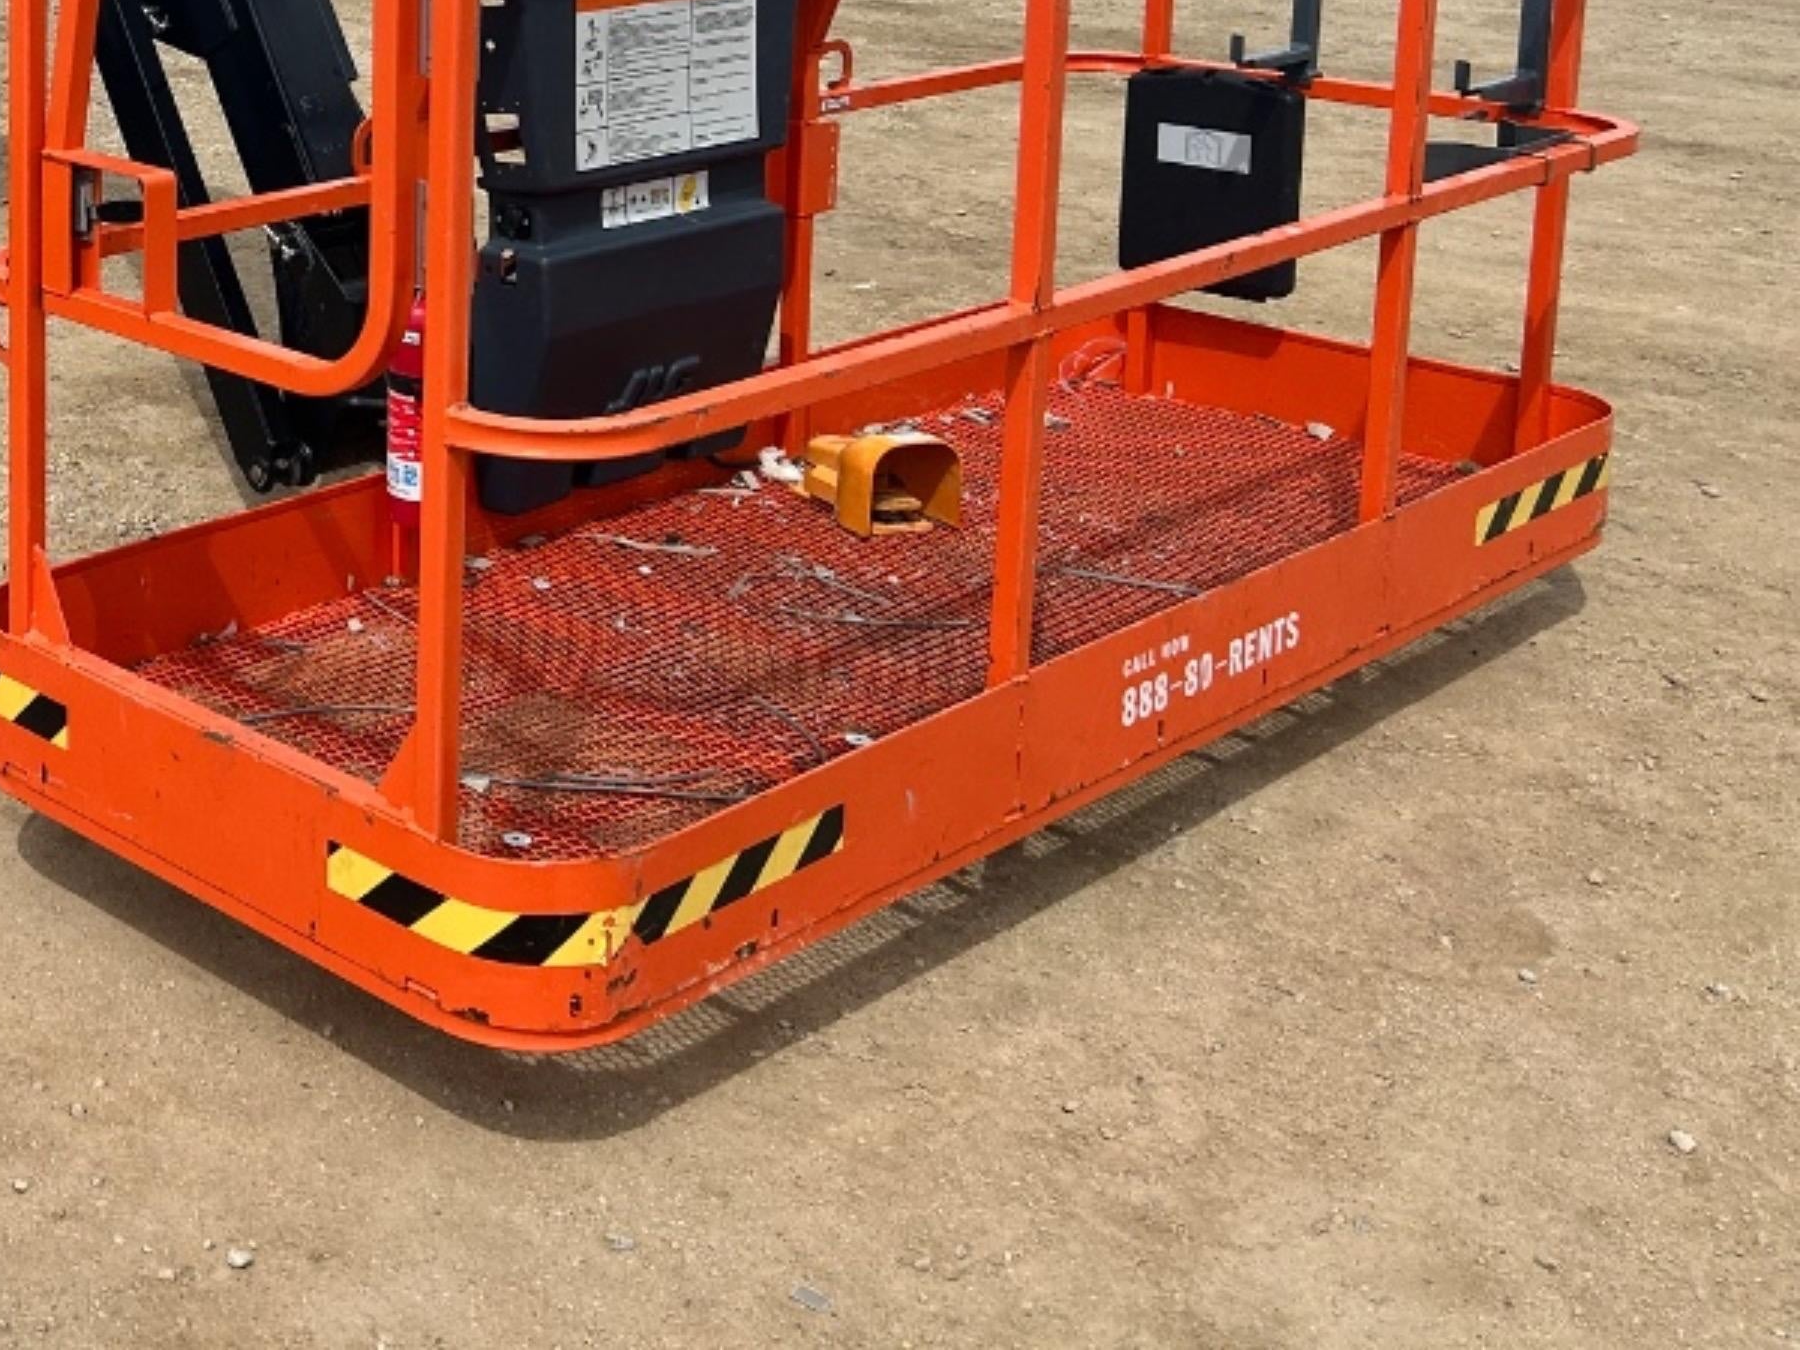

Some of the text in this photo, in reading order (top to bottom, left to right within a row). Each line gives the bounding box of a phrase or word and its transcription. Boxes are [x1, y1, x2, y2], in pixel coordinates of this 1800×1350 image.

[1120, 611, 1301, 728] 888-80-RENTS
[1121, 634, 1190, 678] CALL NOW
